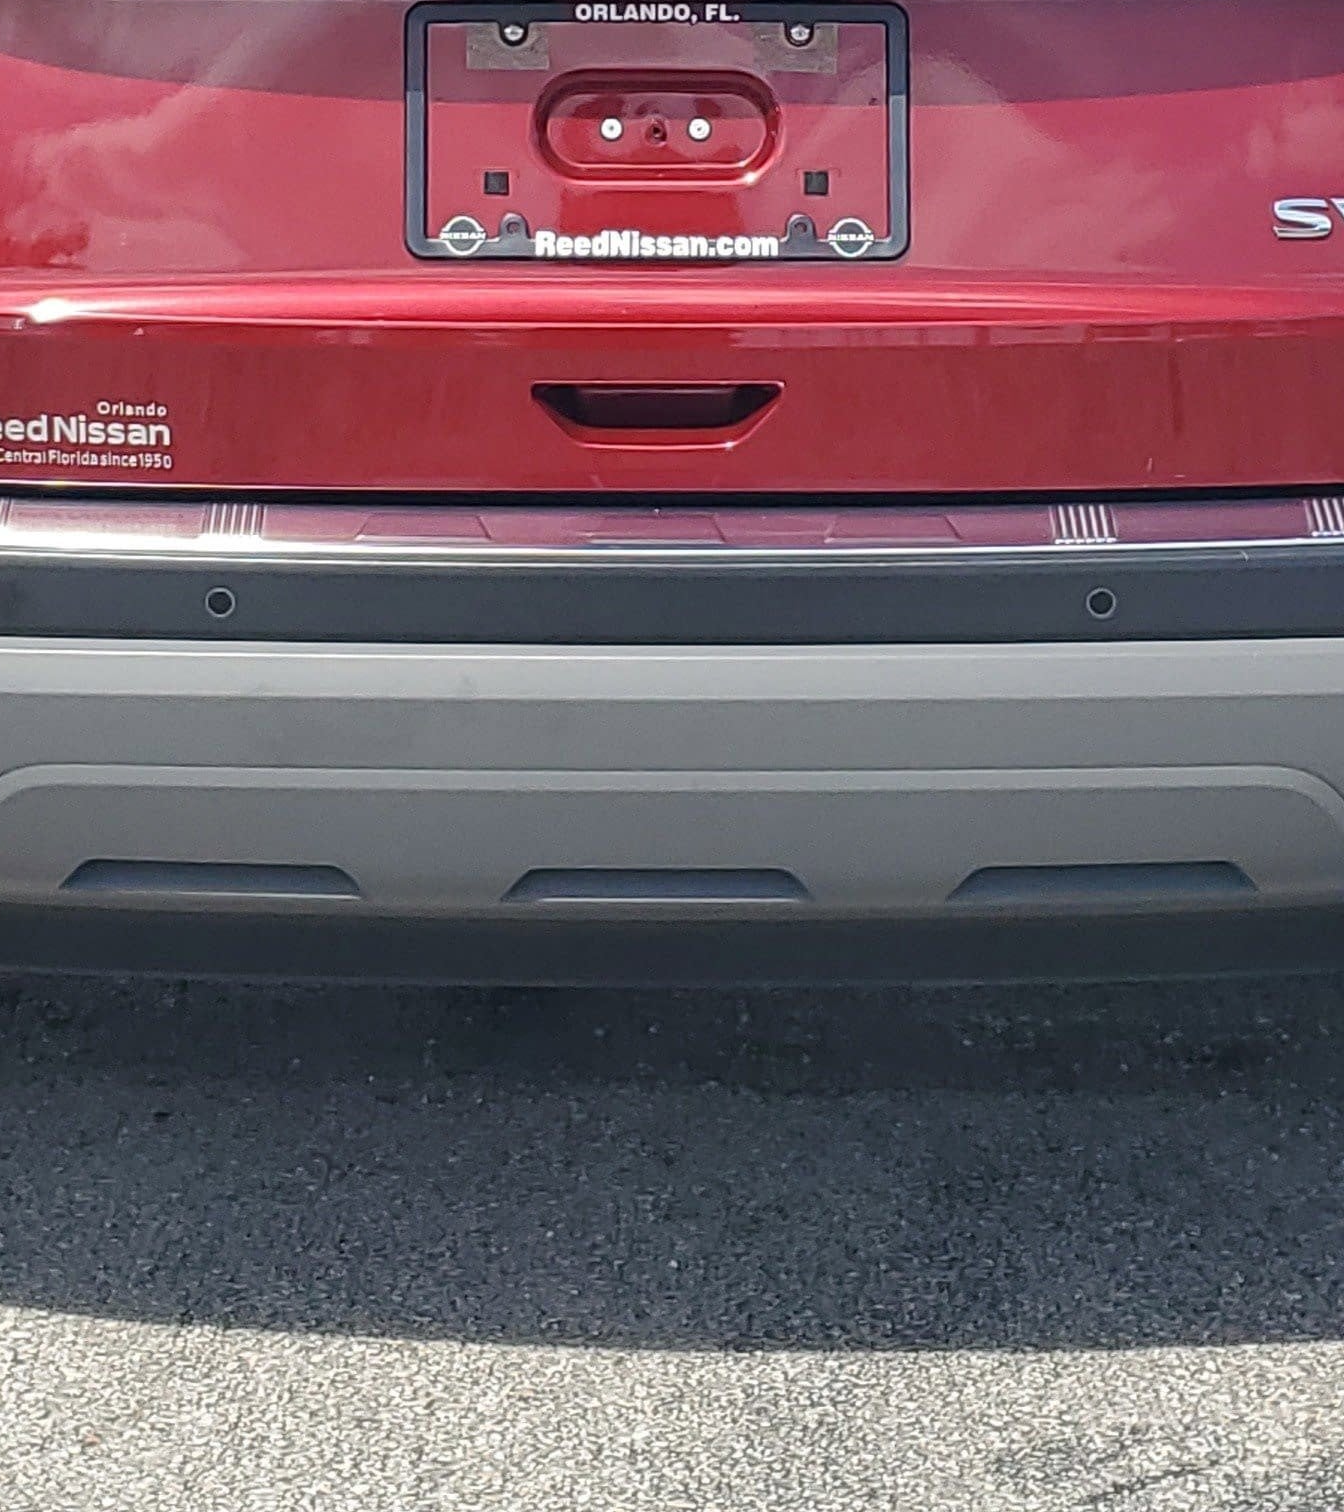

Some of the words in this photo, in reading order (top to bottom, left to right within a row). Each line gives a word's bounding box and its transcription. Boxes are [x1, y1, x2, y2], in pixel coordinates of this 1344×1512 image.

[574, 3, 698, 25] ORLANDO,
[705, 3, 741, 22] FL.
[438, 231, 487, 240] NISSAN
[534, 229, 780, 258] ReedNissan.com
[828, 233, 874, 241] NISSAN
[97, 400, 167, 417] Orlando
[48, 450, 98, 465] Florida
[99, 452, 137, 467] since
[138, 453, 172, 469] 1950
